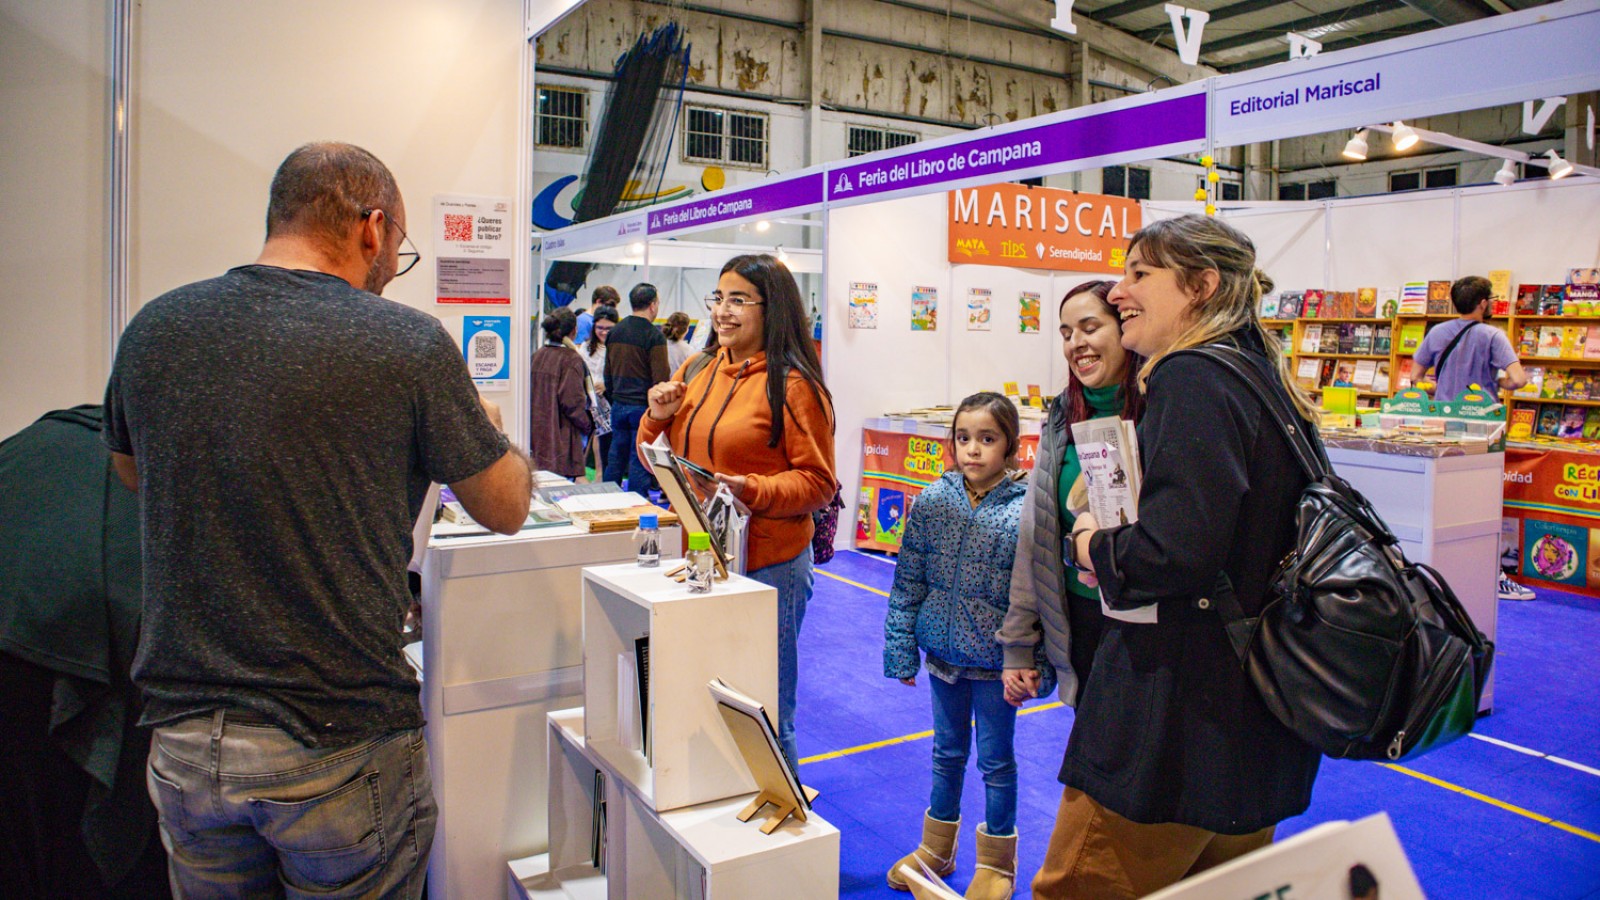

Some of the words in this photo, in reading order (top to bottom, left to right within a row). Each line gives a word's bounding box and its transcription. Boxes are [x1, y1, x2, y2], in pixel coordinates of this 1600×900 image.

[1230, 88, 1299, 116] Editorial
[1305, 72, 1381, 103] Mariscal
[858, 171, 887, 188] Feria
[889, 163, 909, 182] del
[911, 158, 945, 178] Libro
[947, 153, 965, 171] de
[968, 140, 1042, 166] Campana
[663, 212, 678, 225] Feria
[679, 208, 689, 222] del
[690, 206, 707, 220] Libro
[707, 204, 717, 217] de
[717, 198, 753, 215] Campana
[954, 189, 1135, 240] MARISCAL
[478, 225, 502, 234] publicar
[956, 238, 986, 250] MAYA
[1049, 245, 1103, 263] Serendipidad
[1570, 290, 1598, 298] MANGA
[1558, 487, 1578, 498] CON
